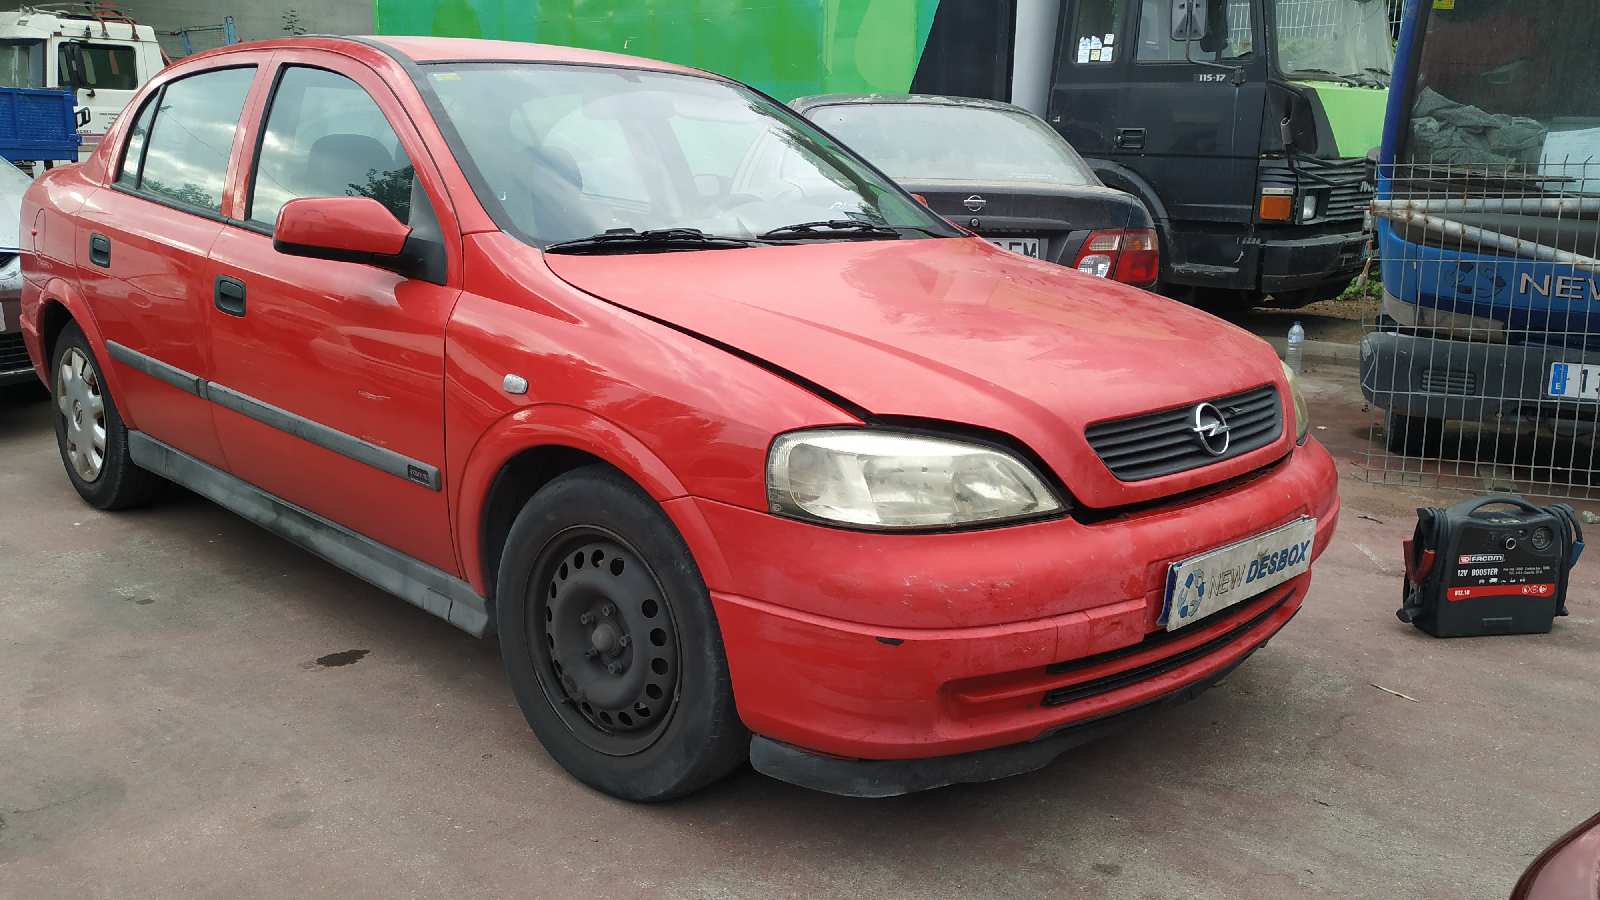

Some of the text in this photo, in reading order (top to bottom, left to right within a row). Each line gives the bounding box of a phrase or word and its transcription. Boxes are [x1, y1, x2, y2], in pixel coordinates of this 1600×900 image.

[1207, 540, 1310, 600] NEW DESBOX
[1457, 569, 1469, 577] 12V
[1471, 567, 1499, 577] BOOSTER
